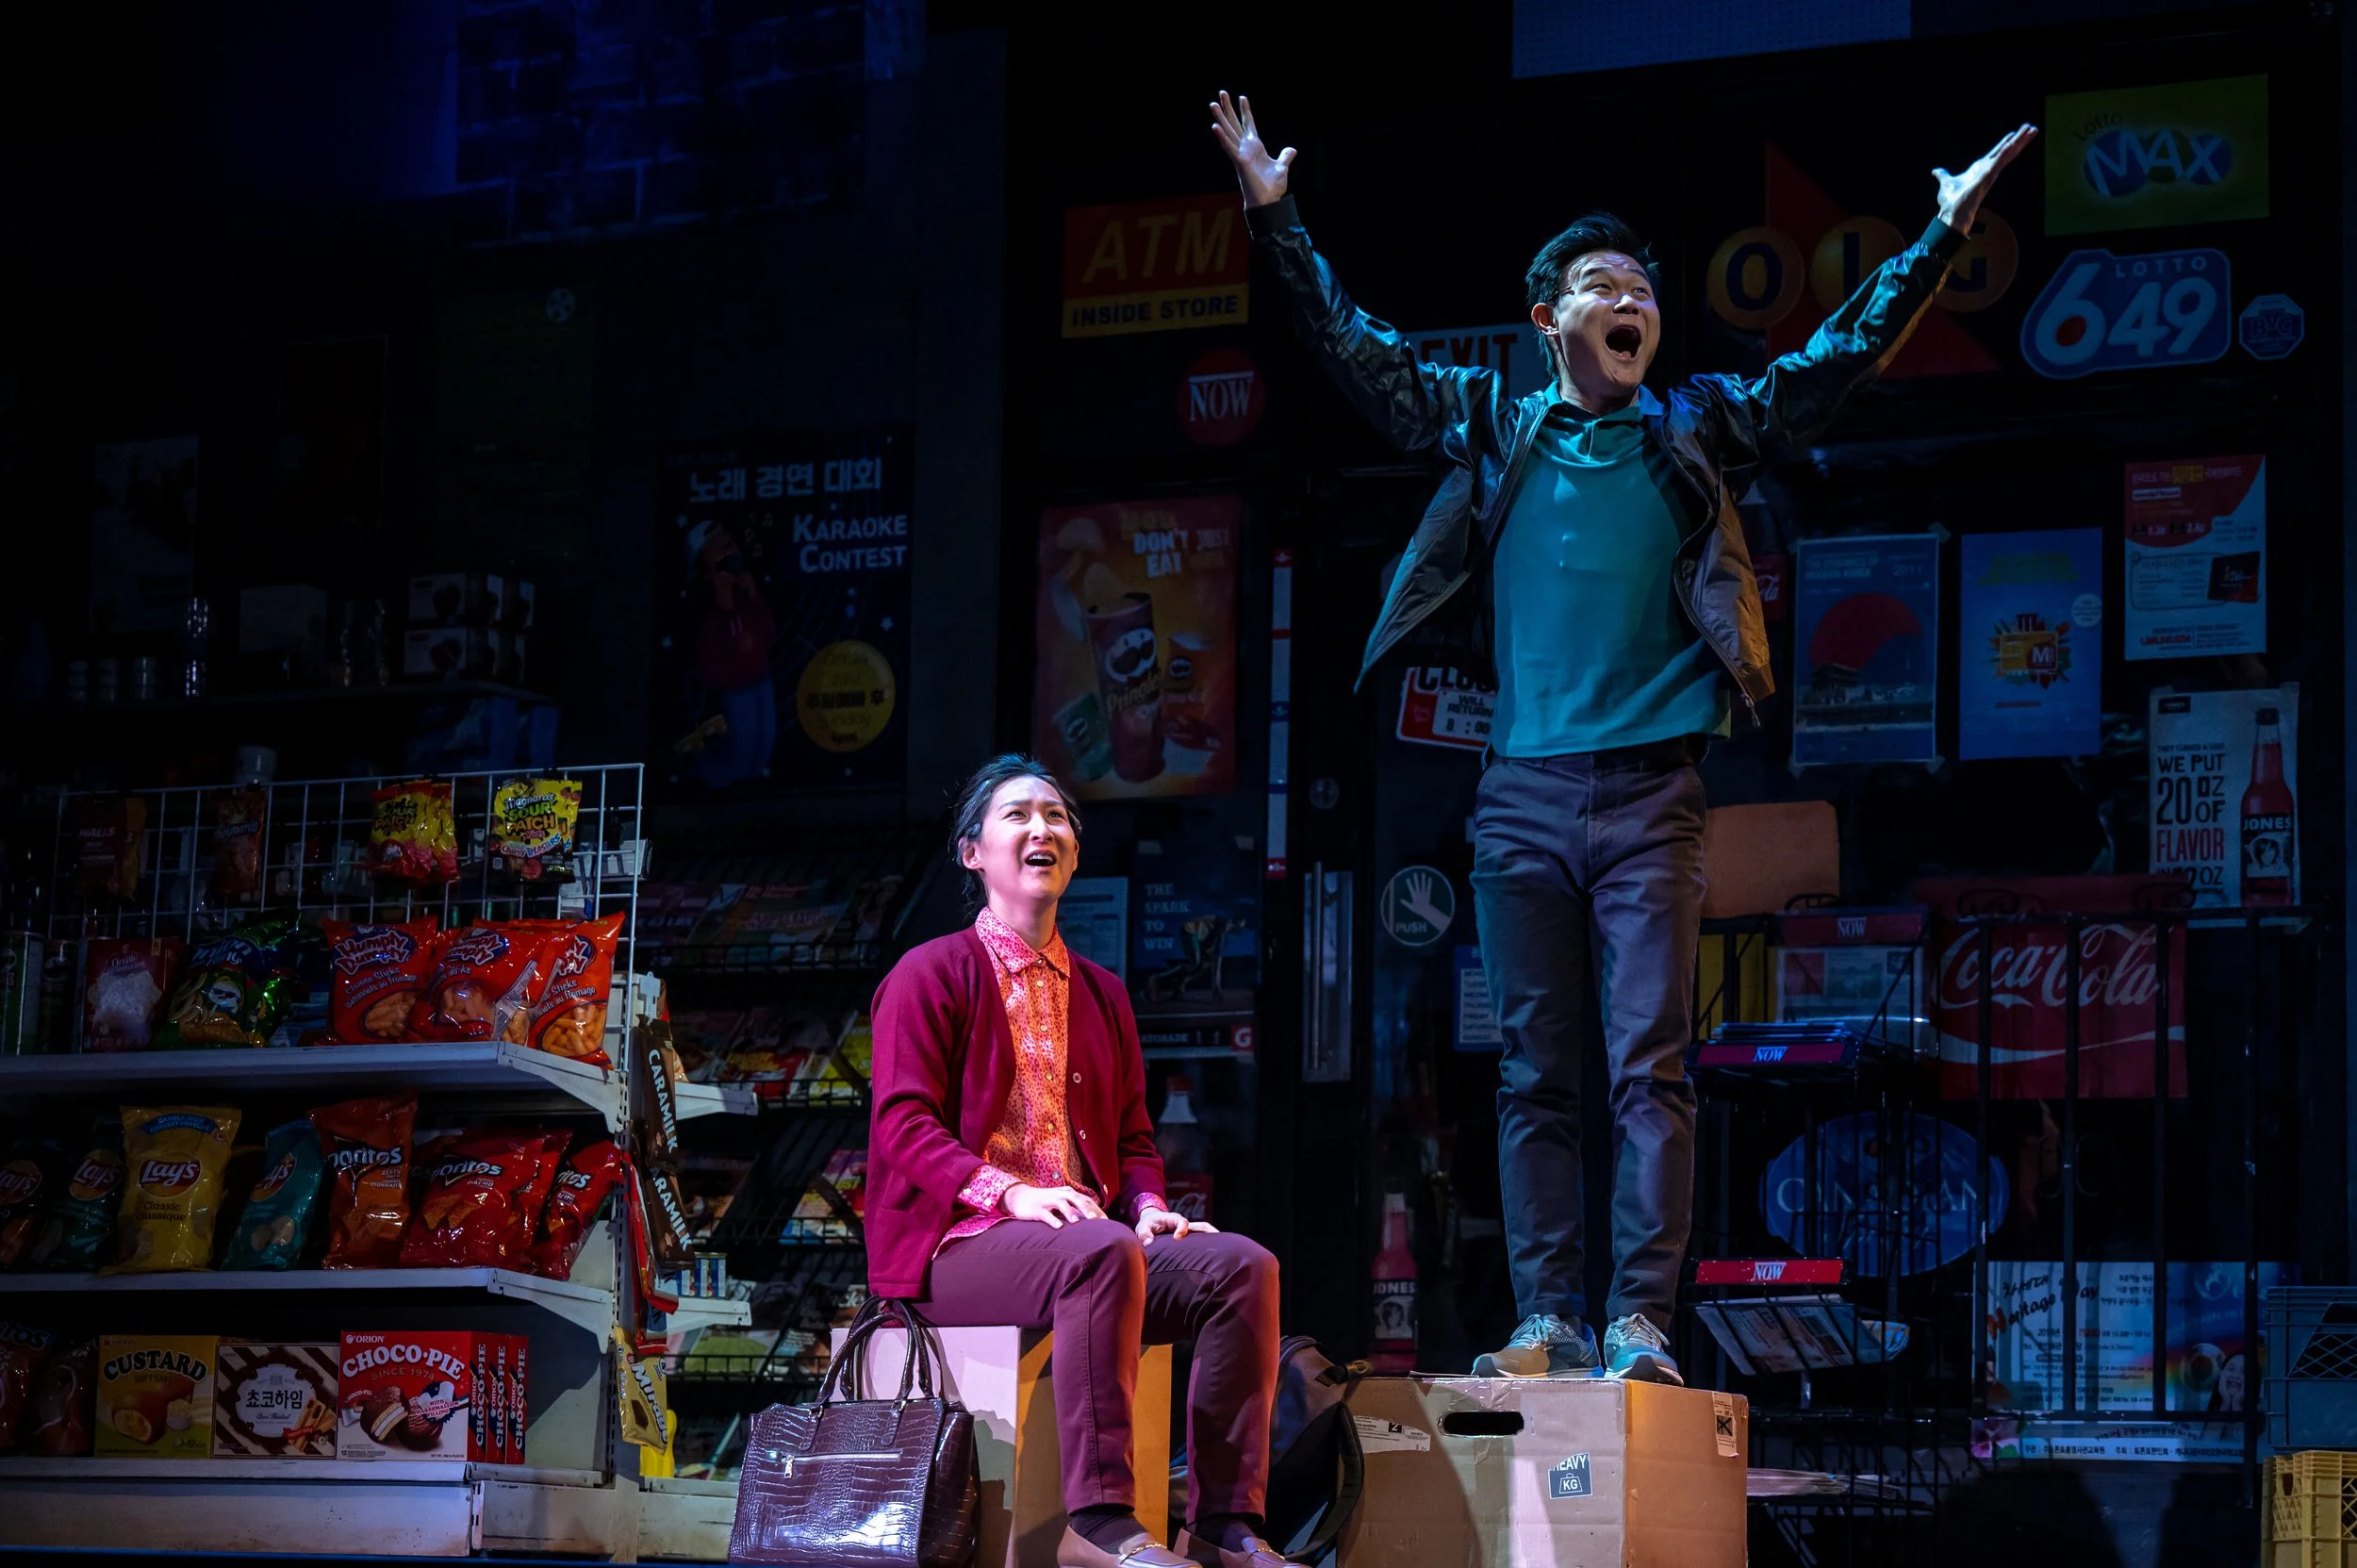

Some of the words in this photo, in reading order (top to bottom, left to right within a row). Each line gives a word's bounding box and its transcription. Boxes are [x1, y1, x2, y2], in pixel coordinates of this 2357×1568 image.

[2075, 111, 2122, 141] Lotto
[2085, 129, 2222, 196] MAX
[1080, 208, 1233, 286] ATM
[2116, 256, 2208, 278] LOTTO
[1073, 304, 1151, 325] INSIDE
[1160, 295, 1238, 320] STORE
[1189, 378, 1253, 422] NOW
[688, 468, 747, 503] 노래
[755, 462, 815, 499] 경연
[823, 456, 882, 493] 대회
[792, 513, 908, 543] KARAOKE
[1133, 528, 1188, 554] DON'T
[799, 545, 908, 573] CONTEST
[1146, 552, 1182, 579] EAT
[1459, 696, 1484, 706] WILL
[2157, 755, 2185, 773] WE
[2191, 754, 2226, 771] PUT
[507, 801, 552, 821] SOUR
[2156, 776, 2192, 825] 20
[2195, 801, 2226, 823] OF
[79, 826, 115, 838] HALLS
[505, 813, 556, 835] PATCH
[2244, 817, 2292, 831] JONES
[2156, 827, 2225, 863] FLAVOR
[2200, 866, 2224, 885] OZ
[1145, 883, 1175, 898] THE
[1144, 900, 1191, 915] SPARK
[1144, 918, 1165, 933] TO
[1395, 921, 1428, 933] PUSH
[1838, 916, 1868, 938] NOW
[1144, 937, 1175, 950] WIN
[1931, 921, 2171, 1011] Coca-Cola
[1233, 1028, 1251, 1048] G
[1753, 1047, 1788, 1063] NOW
[648, 1048, 679, 1154] CARAMILK
[143, 1201, 181, 1212] Classic
[1751, 1262, 1788, 1281] NOW
[1373, 1280, 1416, 1295] JONES
[354, 1335, 386, 1344] ORION
[104, 1349, 206, 1383] CUSTARD
[371, 1367, 406, 1380] SINCE
[411, 1369, 435, 1380] 1974
[1563, 1479, 1578, 1490] KG
